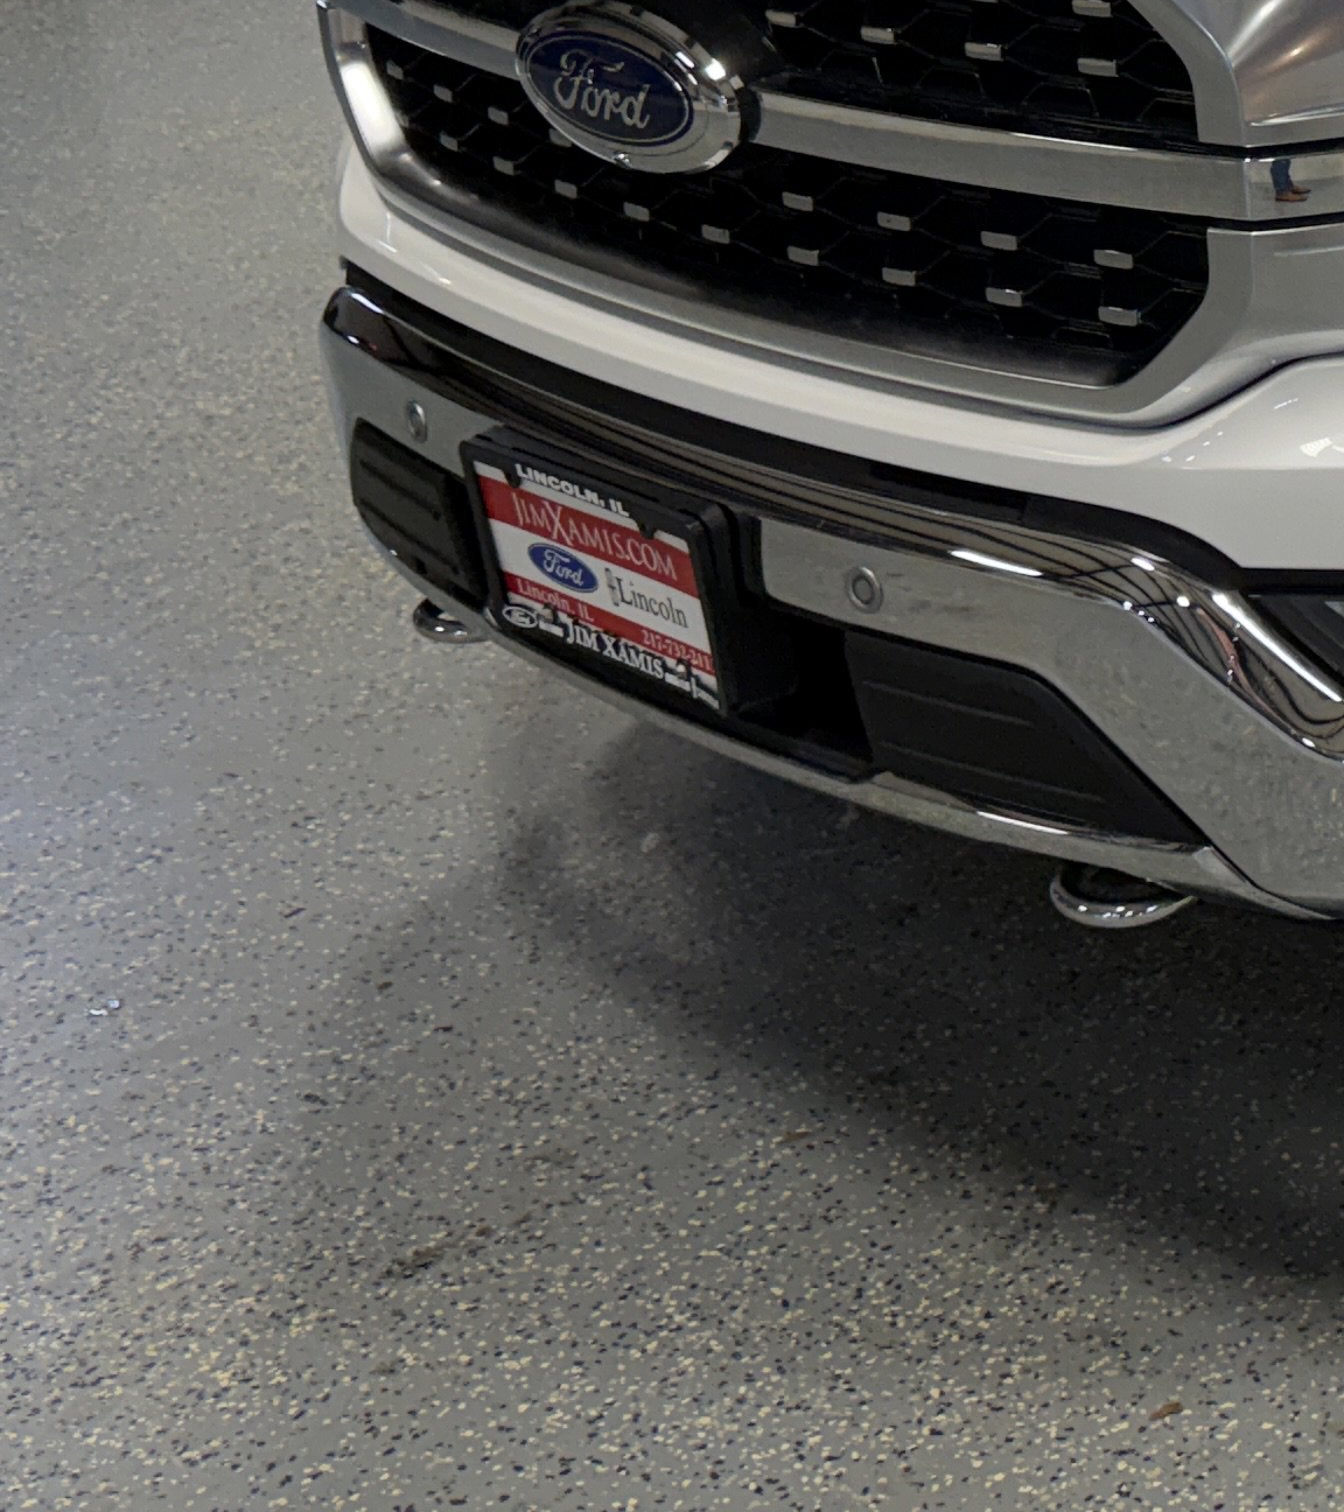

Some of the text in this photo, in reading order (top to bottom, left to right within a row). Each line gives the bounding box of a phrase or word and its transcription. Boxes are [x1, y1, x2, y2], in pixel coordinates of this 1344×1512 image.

[553, 49, 651, 130] Ford
[609, 497, 630, 518] IL
[543, 548, 585, 588] Ford
[616, 576, 690, 629] Lincoln
[566, 618, 665, 680] JIM XAMIS
